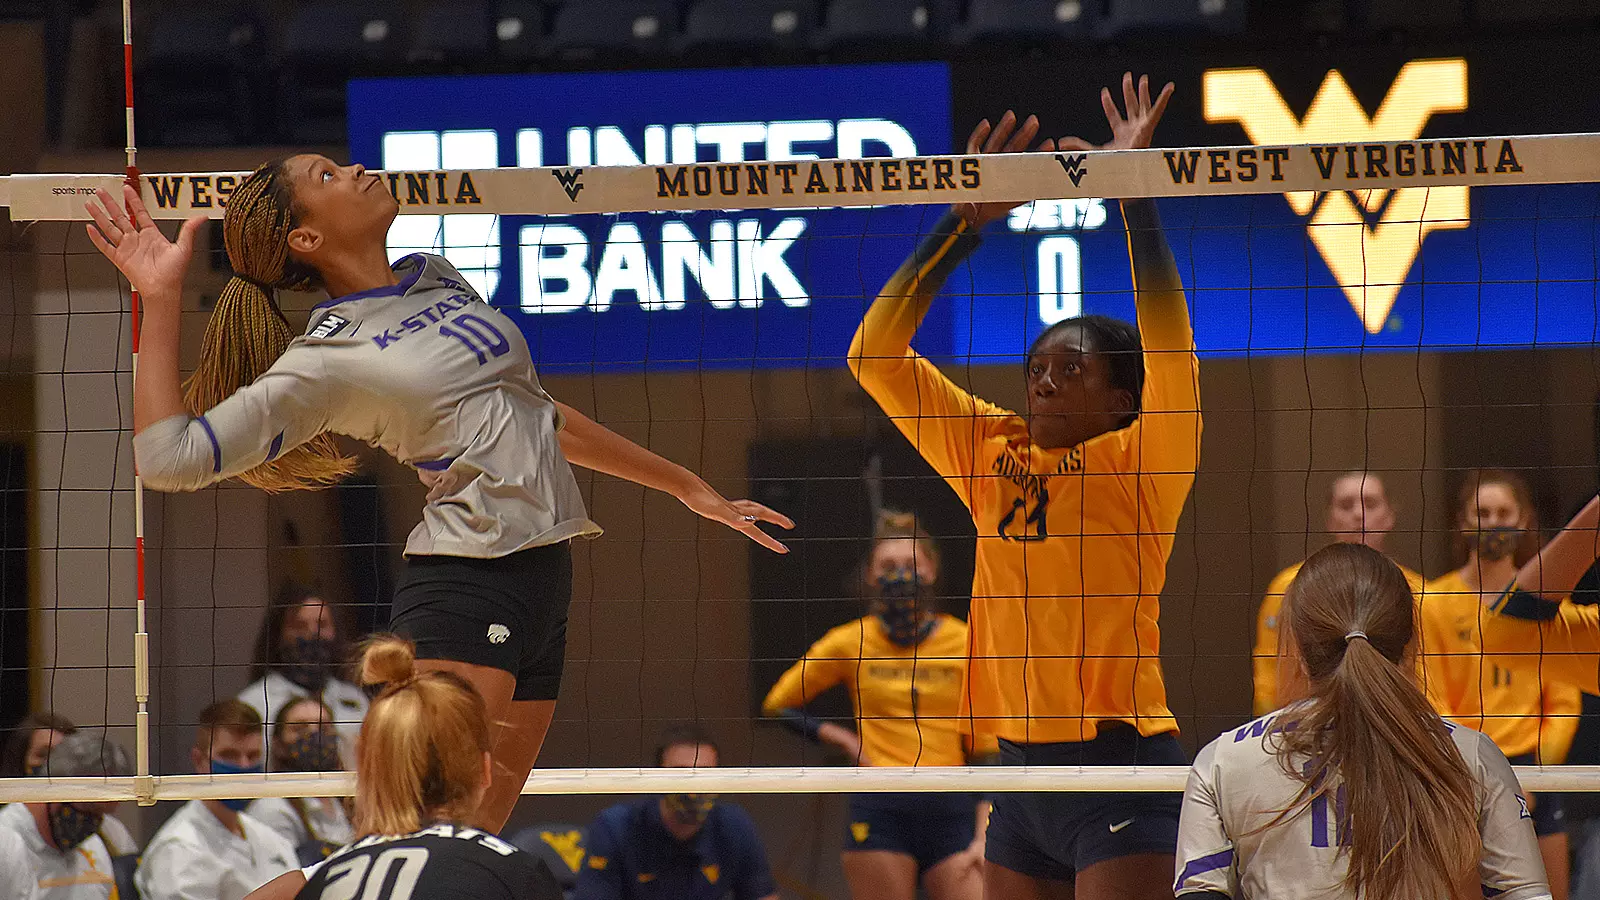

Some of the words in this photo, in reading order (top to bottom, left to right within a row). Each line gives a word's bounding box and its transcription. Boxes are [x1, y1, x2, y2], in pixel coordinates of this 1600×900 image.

[656, 158, 981, 198] MOUNTAINEERS
[1164, 148, 1290, 184] WEST
[1311, 139, 1524, 179] VIRGINIA
[52, 187, 75, 196] sports
[148, 175, 244, 208] WES
[519, 217, 812, 314] BANK
[1037, 235, 1083, 327] 0
[439, 313, 510, 366] 10
